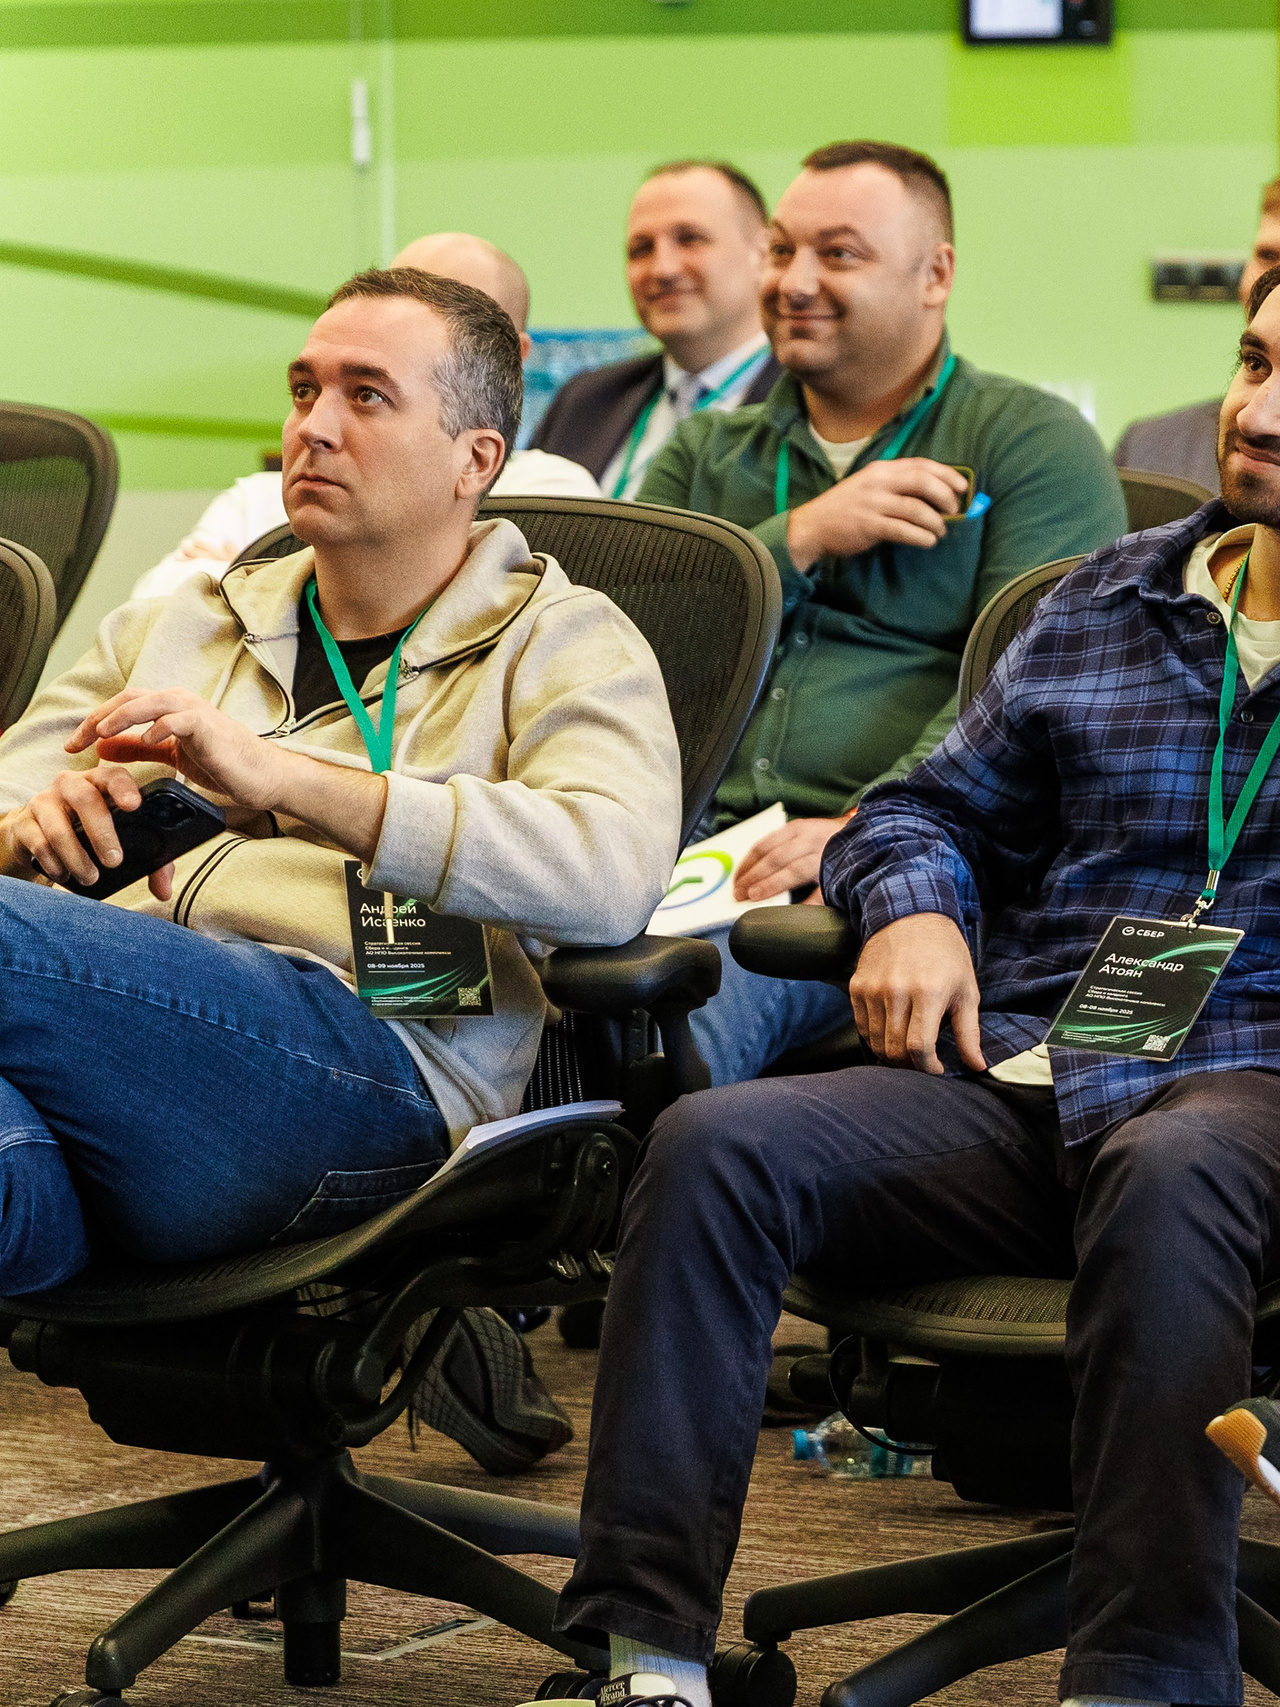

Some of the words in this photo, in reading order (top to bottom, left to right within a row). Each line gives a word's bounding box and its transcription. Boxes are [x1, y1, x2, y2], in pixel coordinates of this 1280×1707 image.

[1136, 928, 1165, 938] СБЕР
[1104, 953, 1184, 973] Александр
[1098, 964, 1143, 978] Атоян
